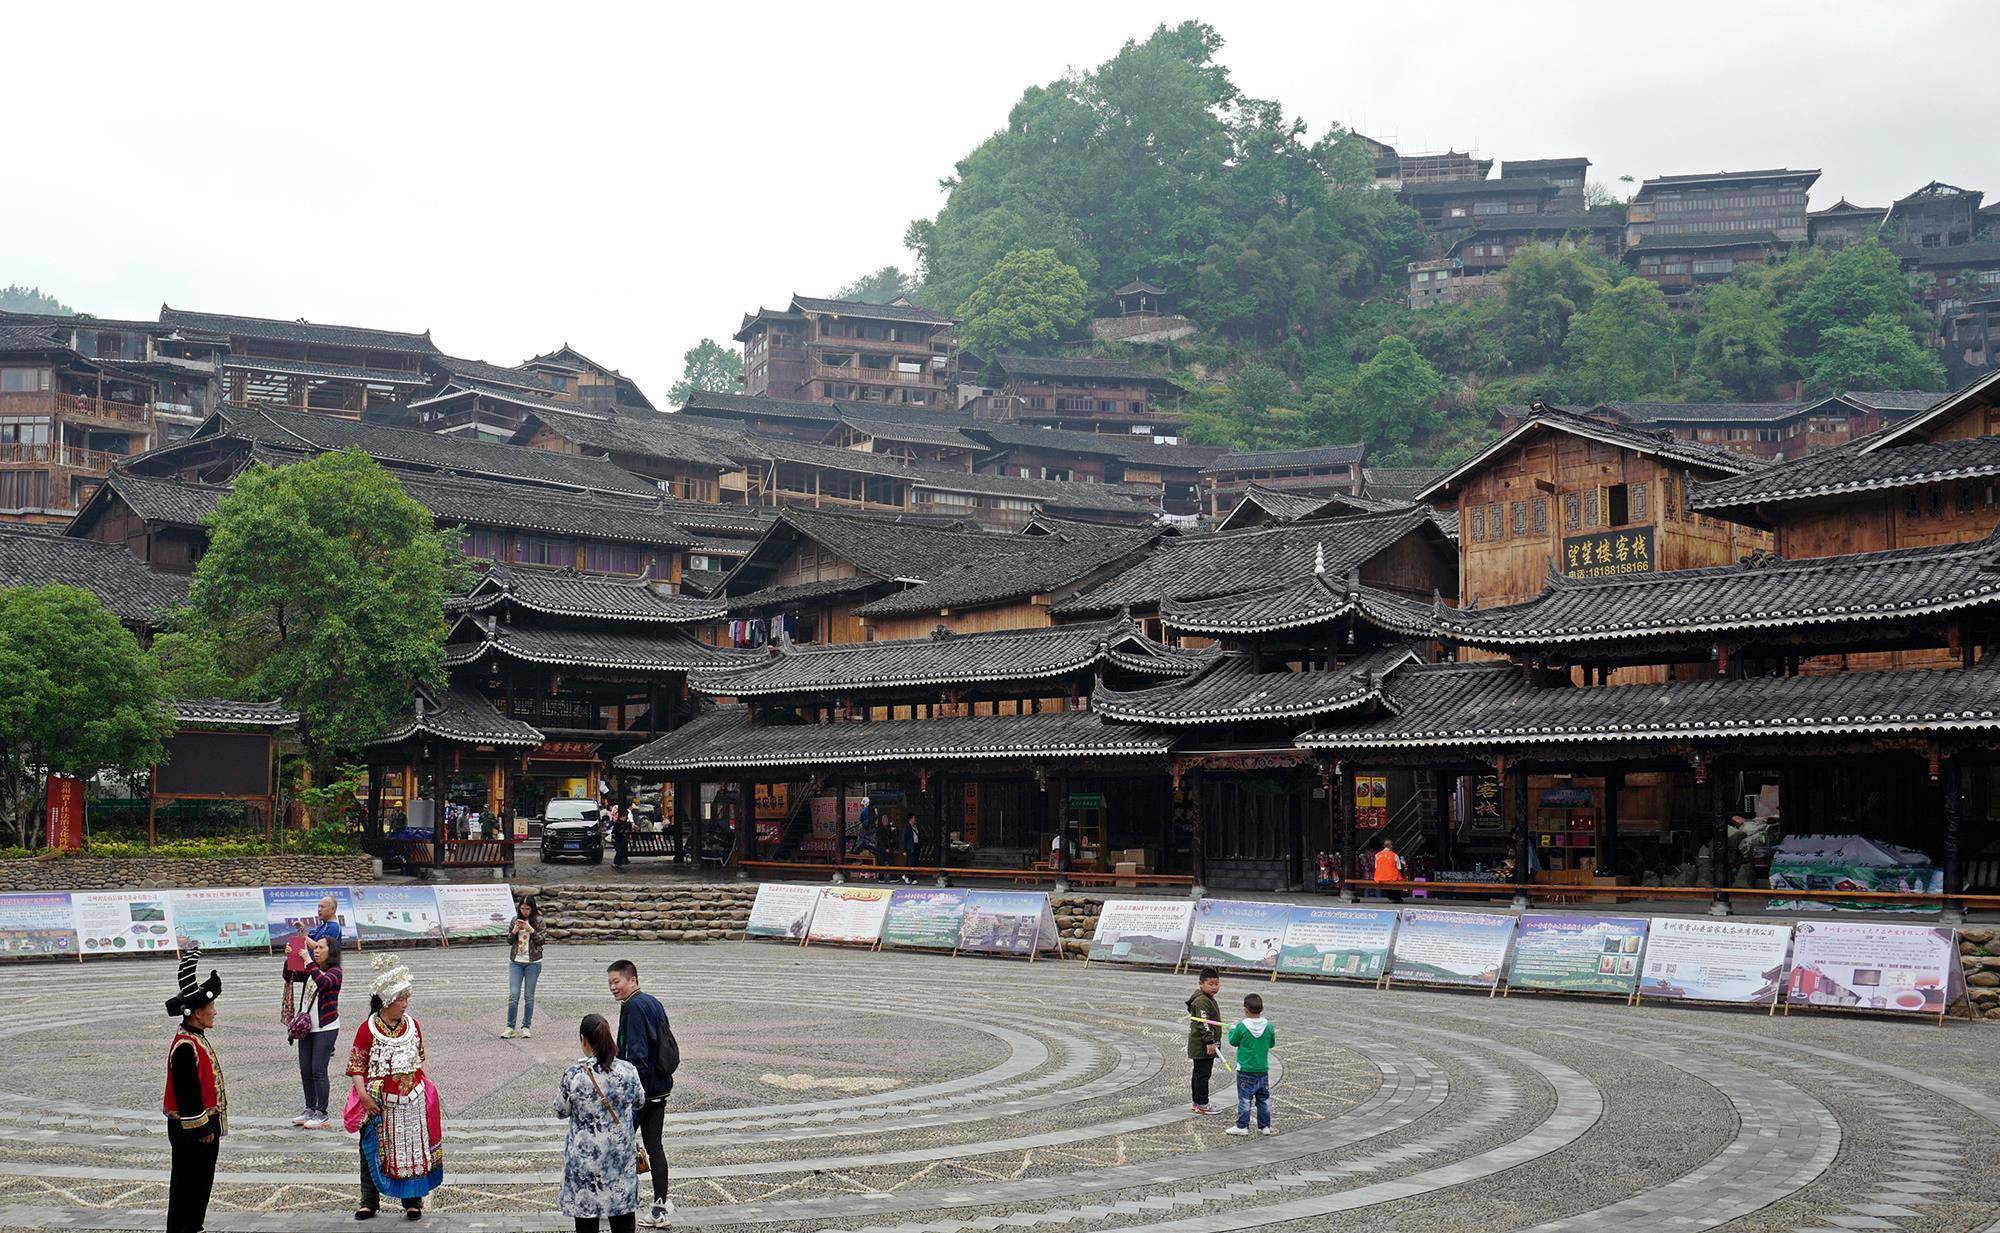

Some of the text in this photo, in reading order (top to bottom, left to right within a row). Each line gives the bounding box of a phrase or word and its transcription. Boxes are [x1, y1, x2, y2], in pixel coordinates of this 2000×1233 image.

[1568, 534, 1648, 567] 望笙楼客栈
